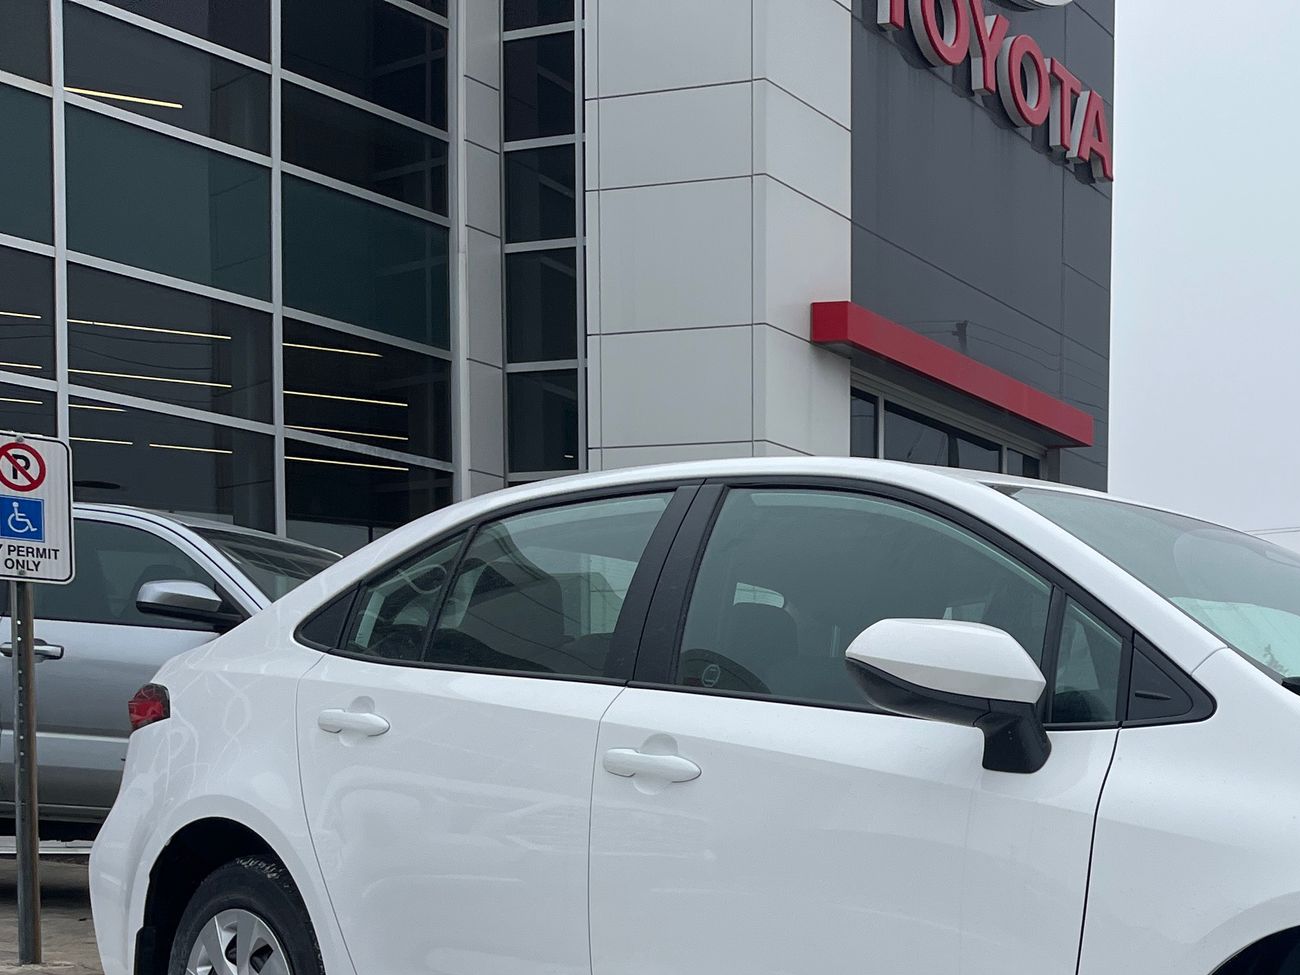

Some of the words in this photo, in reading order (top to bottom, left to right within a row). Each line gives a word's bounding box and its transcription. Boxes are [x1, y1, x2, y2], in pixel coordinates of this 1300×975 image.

[877, 0, 1114, 182] OYOTA
[12, 453, 31, 480] P
[7, 544, 60, 560] PERMIT
[4, 558, 41, 572] ONLY
